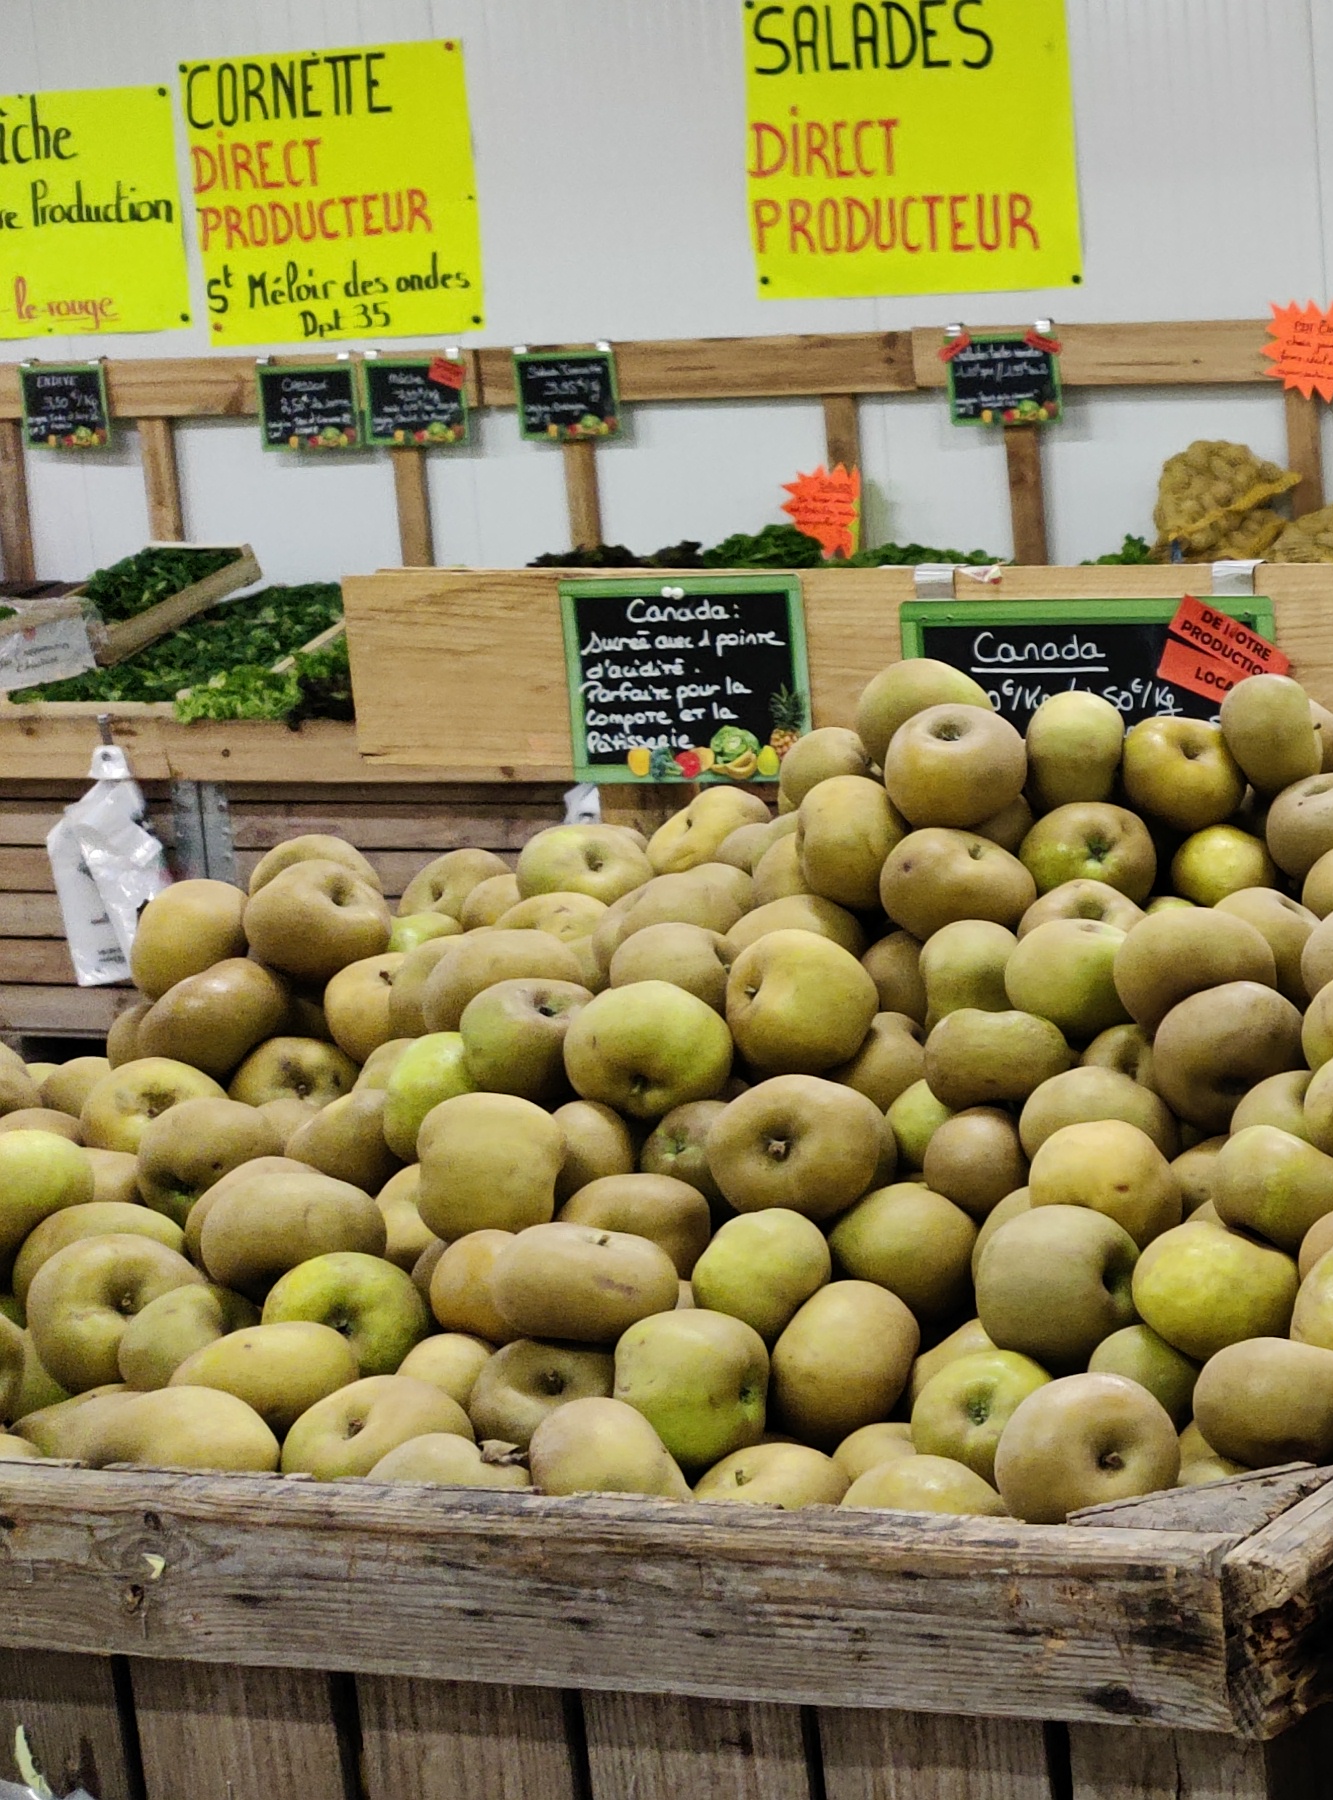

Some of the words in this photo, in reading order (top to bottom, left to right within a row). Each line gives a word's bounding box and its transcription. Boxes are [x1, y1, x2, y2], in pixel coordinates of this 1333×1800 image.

[754, 0, 993, 74] SALADES
[31, 178, 173, 227] Production
[201, 188, 432, 251] PRODUCTEUR
[752, 192, 1040, 254] PRODUCTEUR
[248, 261, 336, 308] Méloir
[344, 259, 388, 297] des
[396, 251, 470, 293] ondes
[351, 301, 391, 330] 35
[1201, 610, 1223, 630] DE
[973, 631, 1106, 662] Canada
[1181, 620, 1269, 676] PRODUCTIO
[725, 676, 752, 695] la
[1195, 667, 1236, 691] LOCA
[712, 702, 739, 719] la
